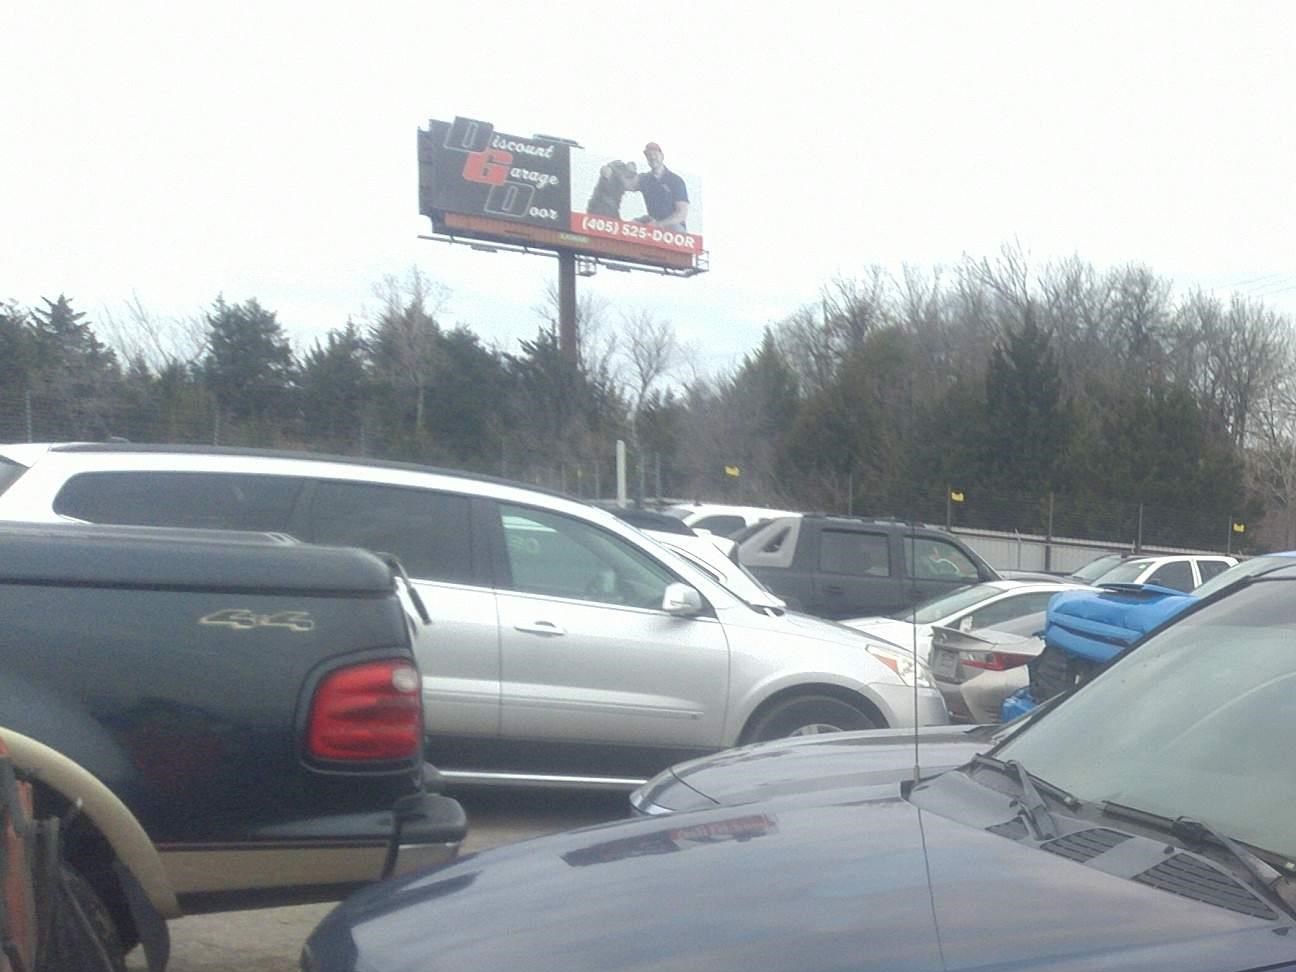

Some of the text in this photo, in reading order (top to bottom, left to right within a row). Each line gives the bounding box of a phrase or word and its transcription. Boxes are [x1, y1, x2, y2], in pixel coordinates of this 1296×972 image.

[443, 116, 554, 159] Discount
[462, 149, 559, 189] Garage
[484, 180, 559, 219] Door
[582, 217, 695, 248] (405) 525-DOOR
